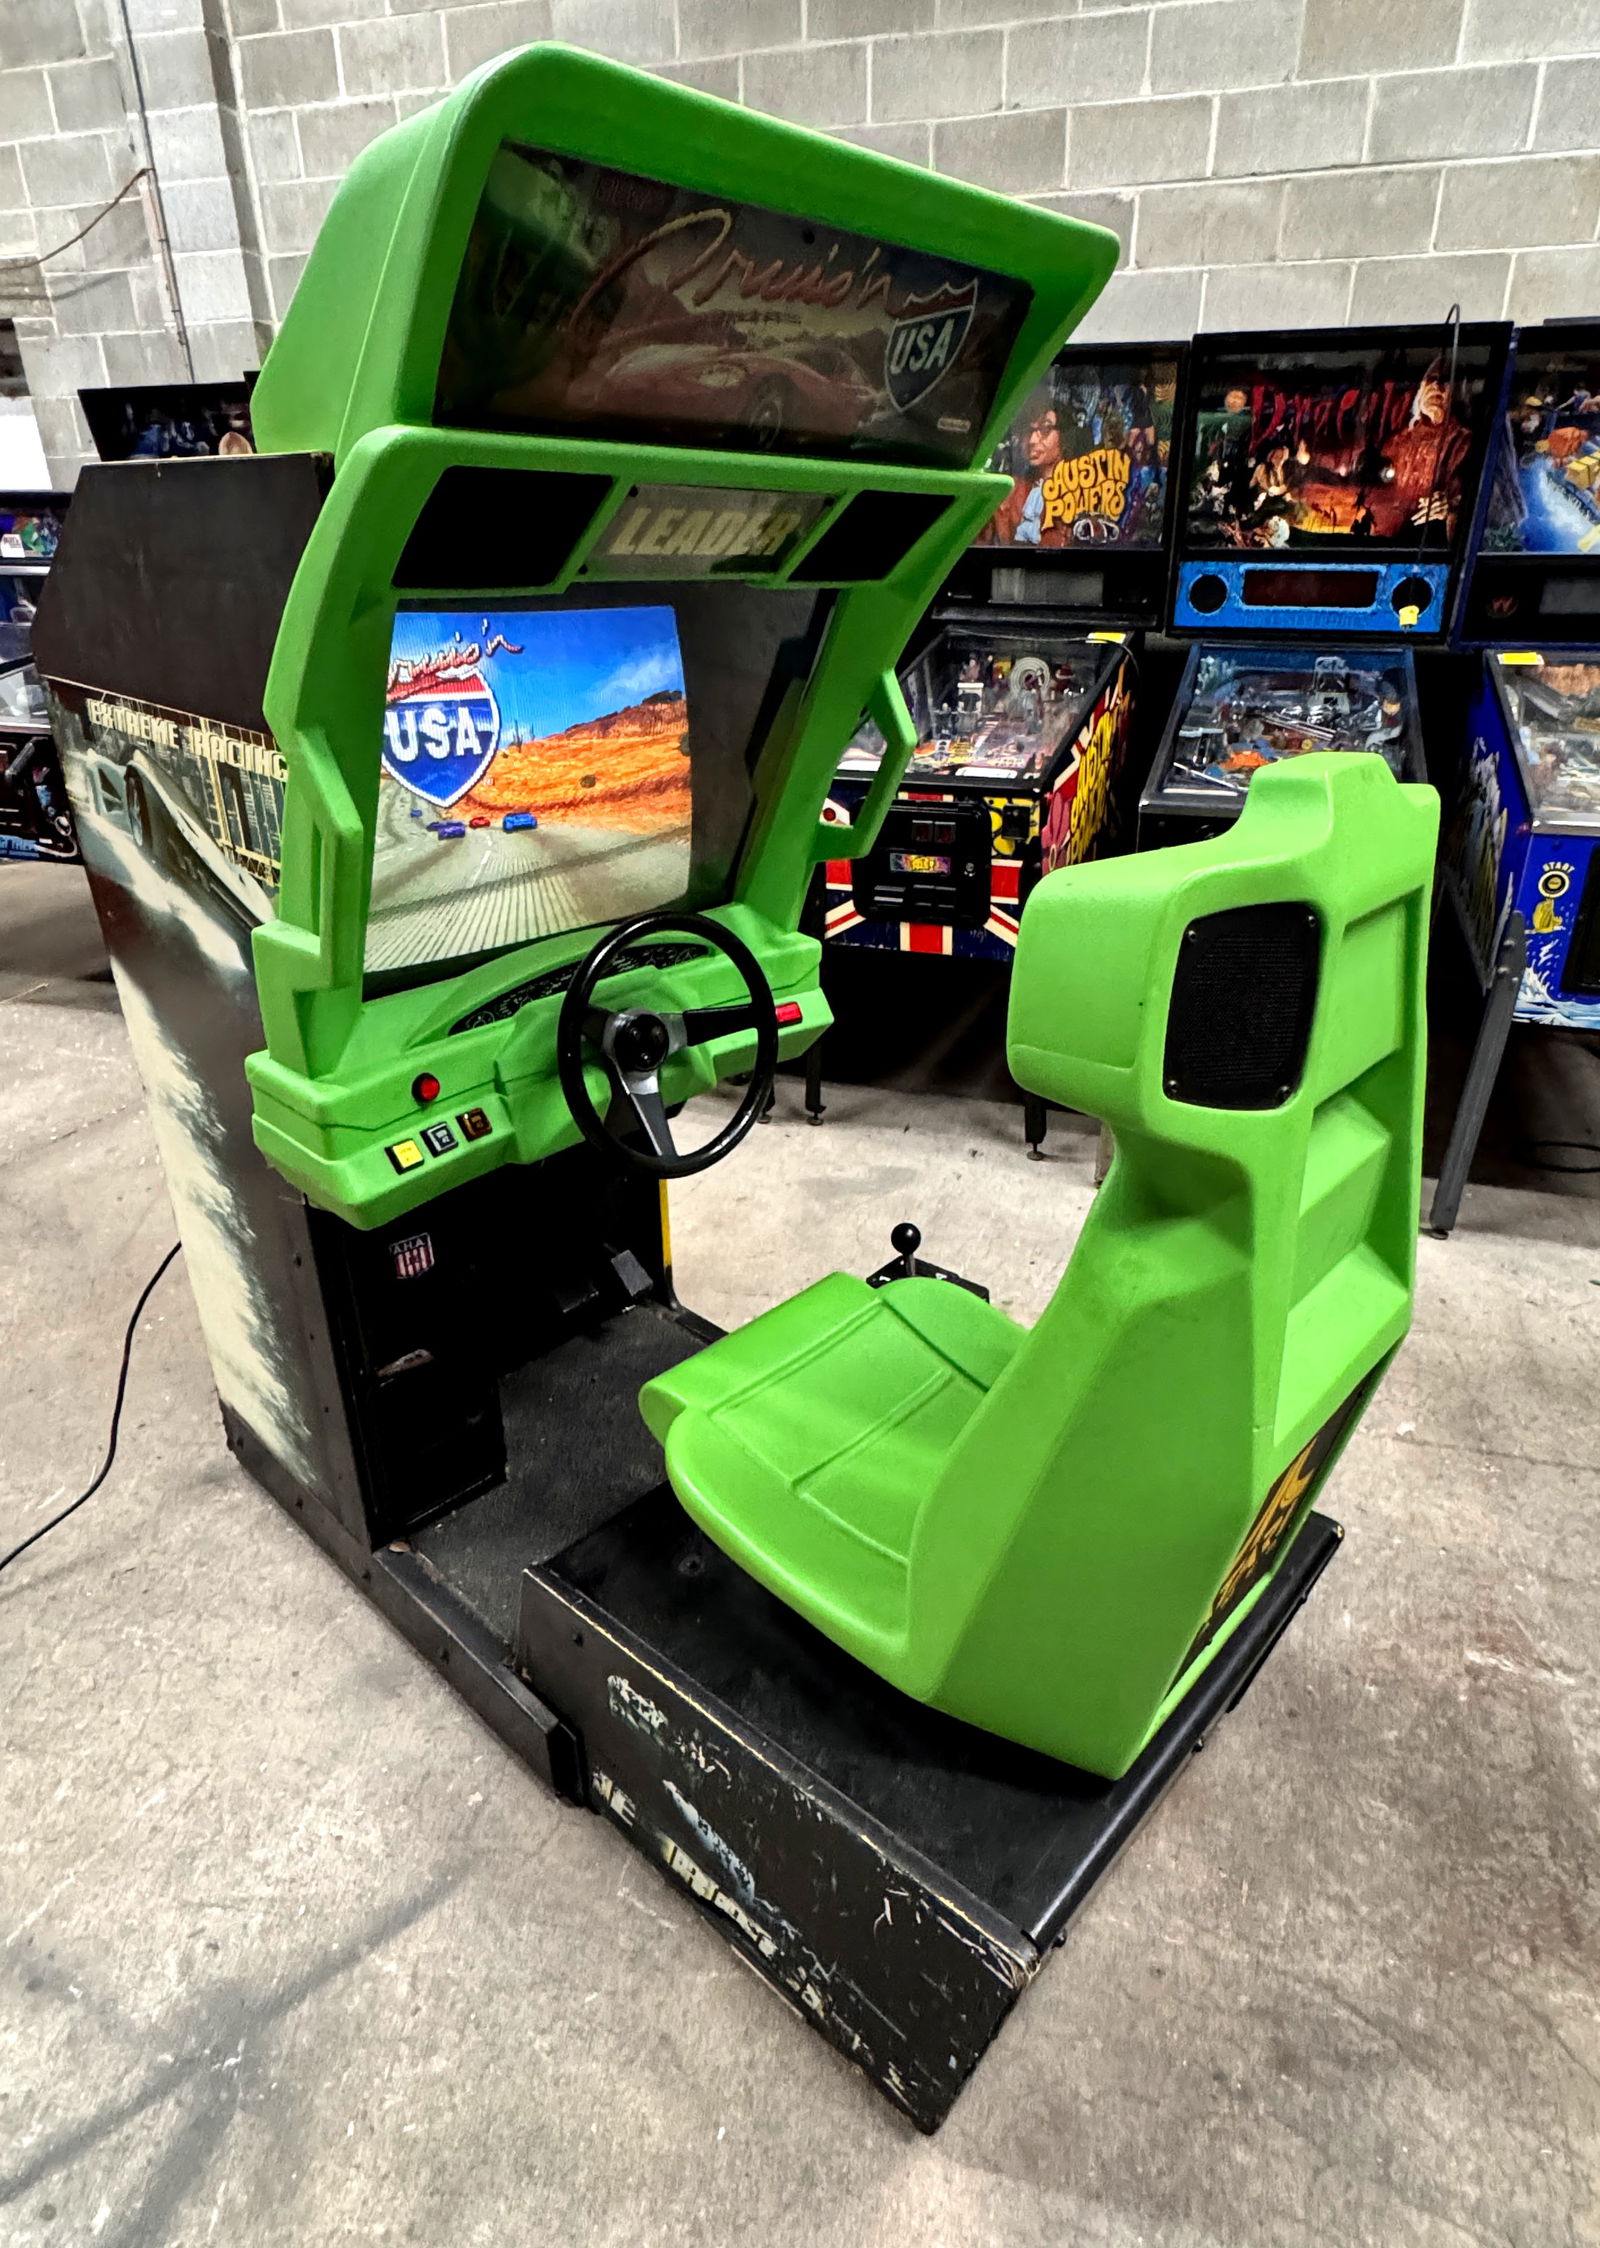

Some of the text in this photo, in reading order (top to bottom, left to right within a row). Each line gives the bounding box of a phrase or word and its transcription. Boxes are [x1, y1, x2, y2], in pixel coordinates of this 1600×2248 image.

[889, 317, 956, 375] USA
[1042, 447, 1131, 501] AUSTIN
[609, 506, 801, 556] LEADER
[1041, 481, 1127, 529] POWERS
[387, 618, 523, 696] ruis'n
[87, 698, 288, 783] EXTREME RACING
[385, 706, 483, 763] USA
[1542, 861, 1576, 873] START
